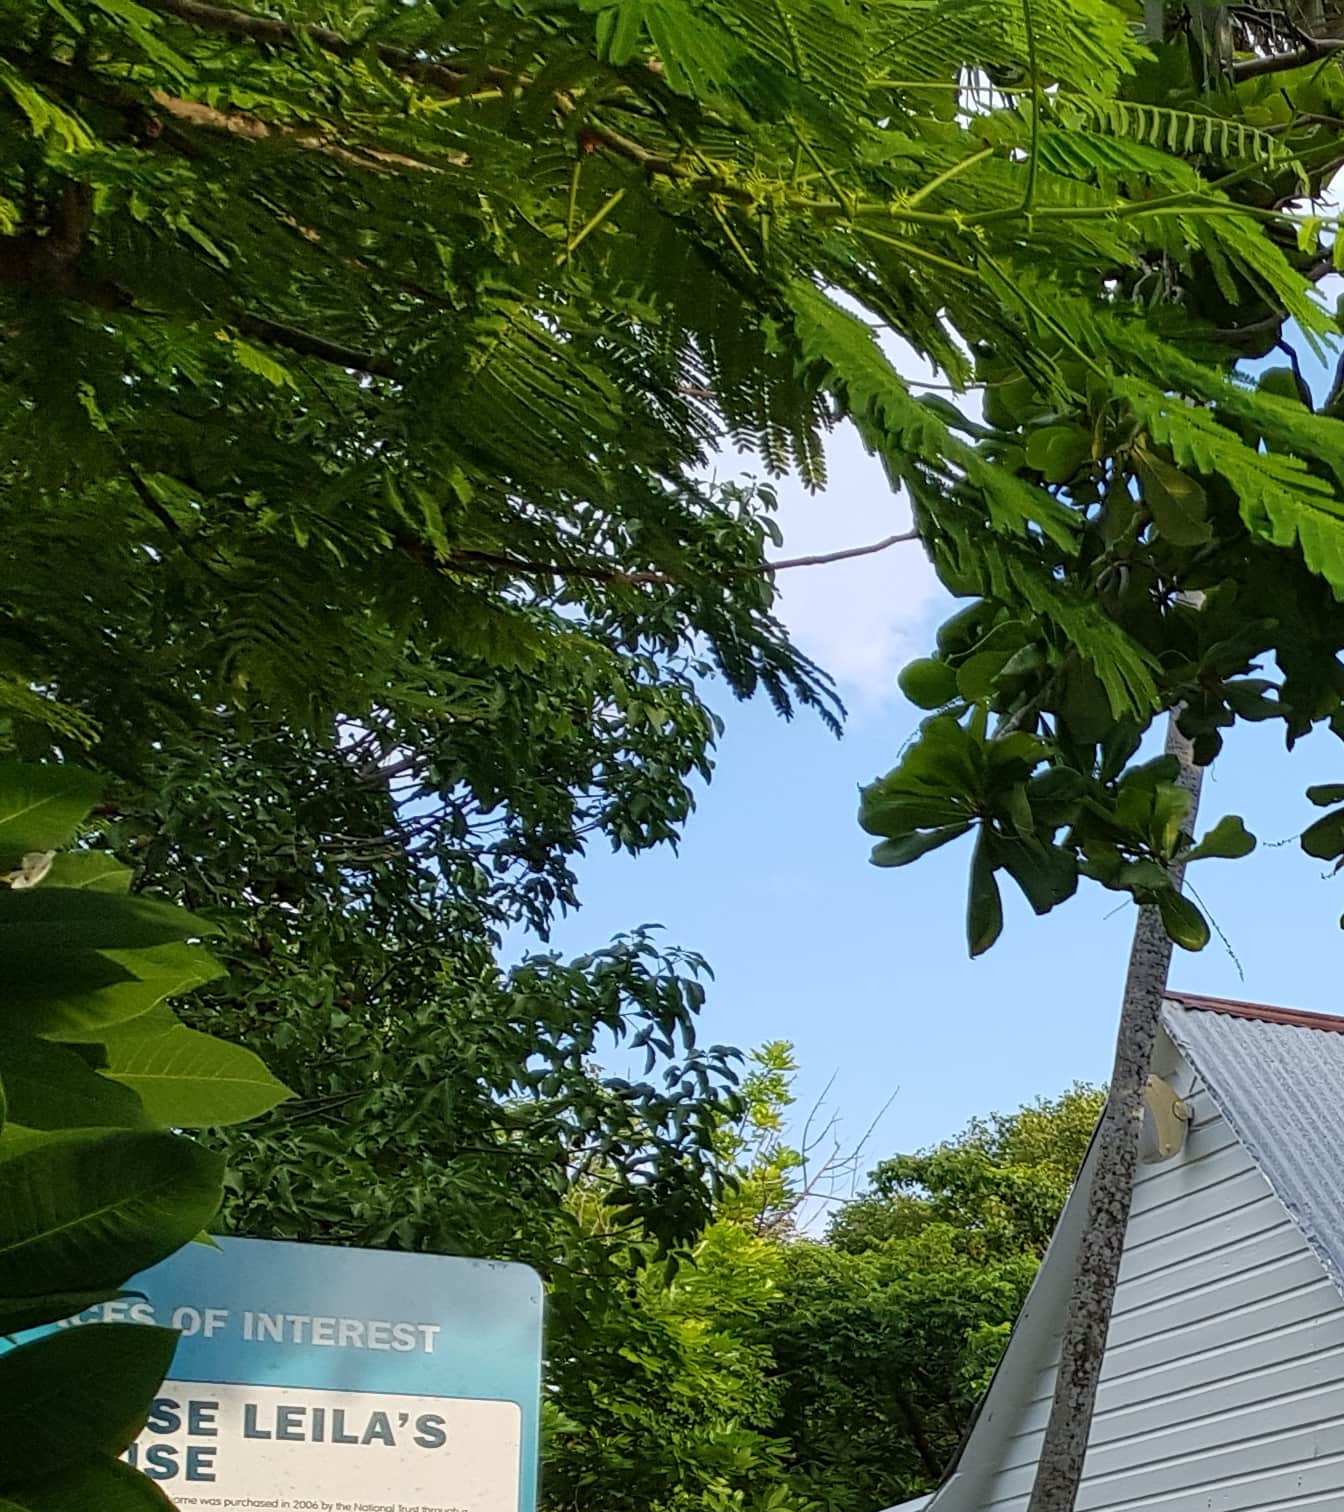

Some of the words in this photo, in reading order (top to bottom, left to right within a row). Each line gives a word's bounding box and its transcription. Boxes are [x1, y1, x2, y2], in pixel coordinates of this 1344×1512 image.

[57, 1302, 155, 1327] CES
[171, 1306, 229, 1337] OF
[243, 1311, 441, 1353] INTEREST
[145, 1398, 219, 1436] SE
[200, 1498, 221, 1506] was
[224, 1498, 278, 1508] purchased
[281, 1500, 289, 1508] in
[293, 1500, 318, 1509] 2006
[321, 1501, 333, 1512] by
[336, 1502, 351, 1511] the
[354, 1503, 395, 1512] National
